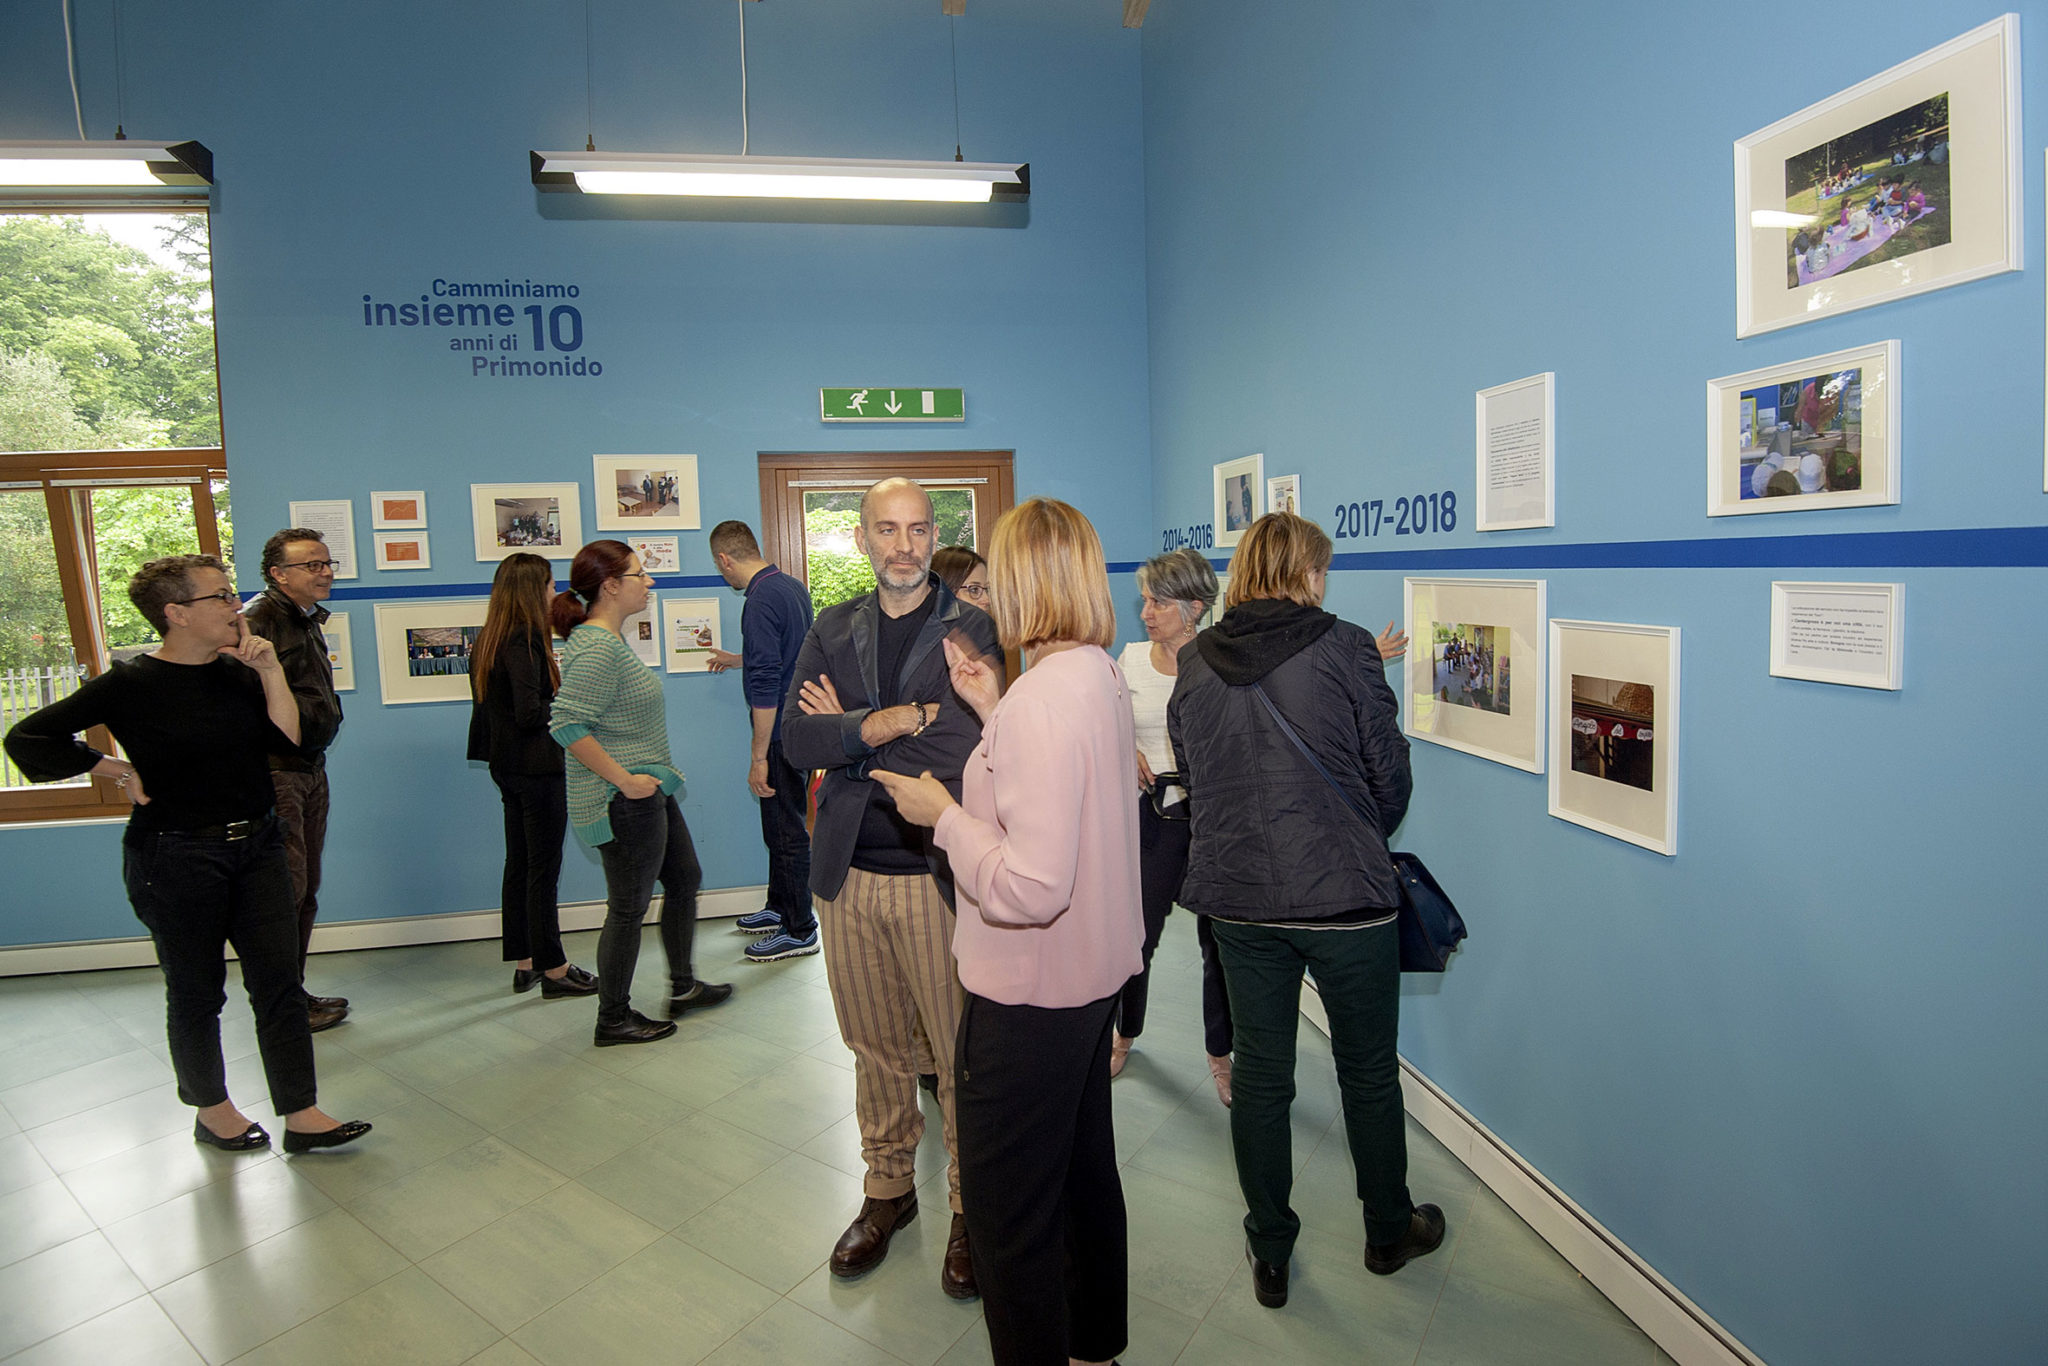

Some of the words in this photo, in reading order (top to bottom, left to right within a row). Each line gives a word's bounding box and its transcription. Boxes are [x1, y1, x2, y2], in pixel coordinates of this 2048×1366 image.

[432, 278, 580, 299] Camminiamo
[362, 294, 515, 327] insieme
[523, 304, 584, 352] 10
[449, 333, 494, 351] anni
[499, 333, 518, 351] di
[471, 355, 603, 377] Primonido
[1335, 490, 1457, 539] 2017-2018
[1162, 523, 1213, 552] 2014-2016
